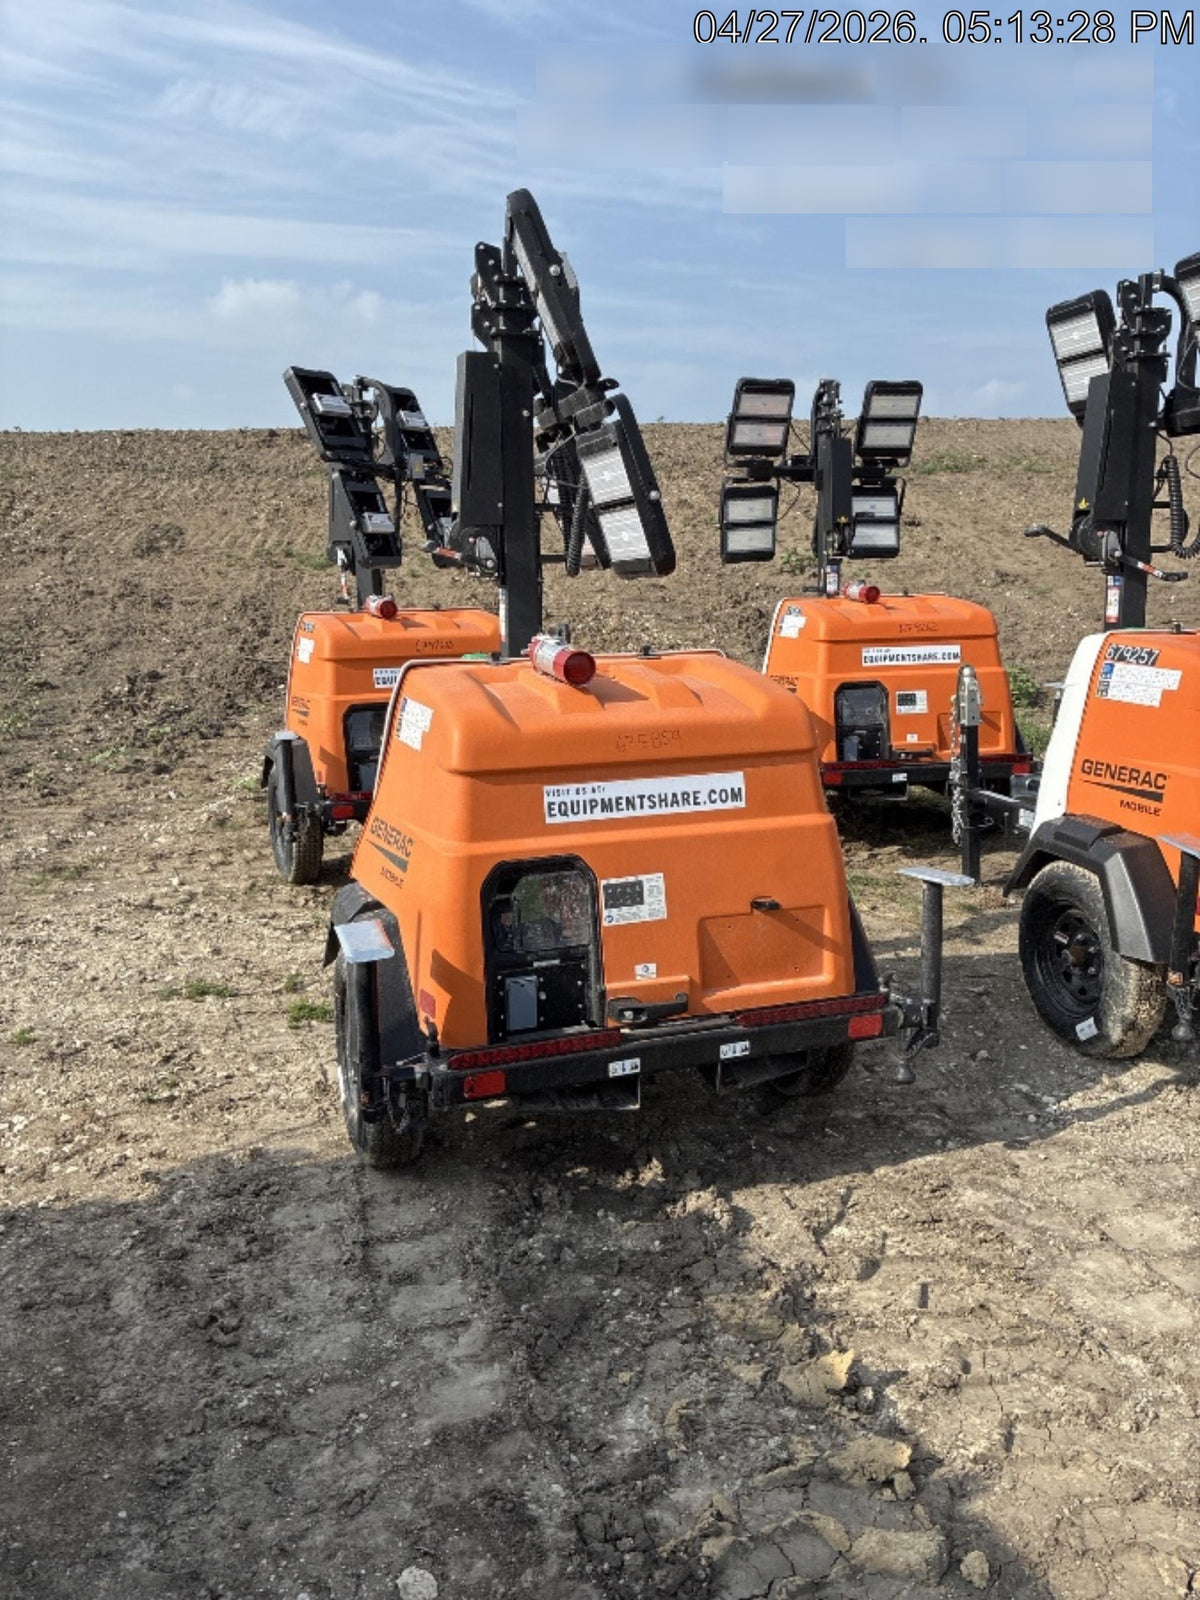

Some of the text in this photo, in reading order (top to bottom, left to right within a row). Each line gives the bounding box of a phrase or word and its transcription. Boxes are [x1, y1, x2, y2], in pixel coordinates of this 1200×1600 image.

[1105, 643, 1160, 666] 679257
[1081, 758, 1168, 790] GENERAC
[547, 787, 743, 818] EQUIPMENTSHARE.COM
[1119, 799, 1162, 817] MOBILE
